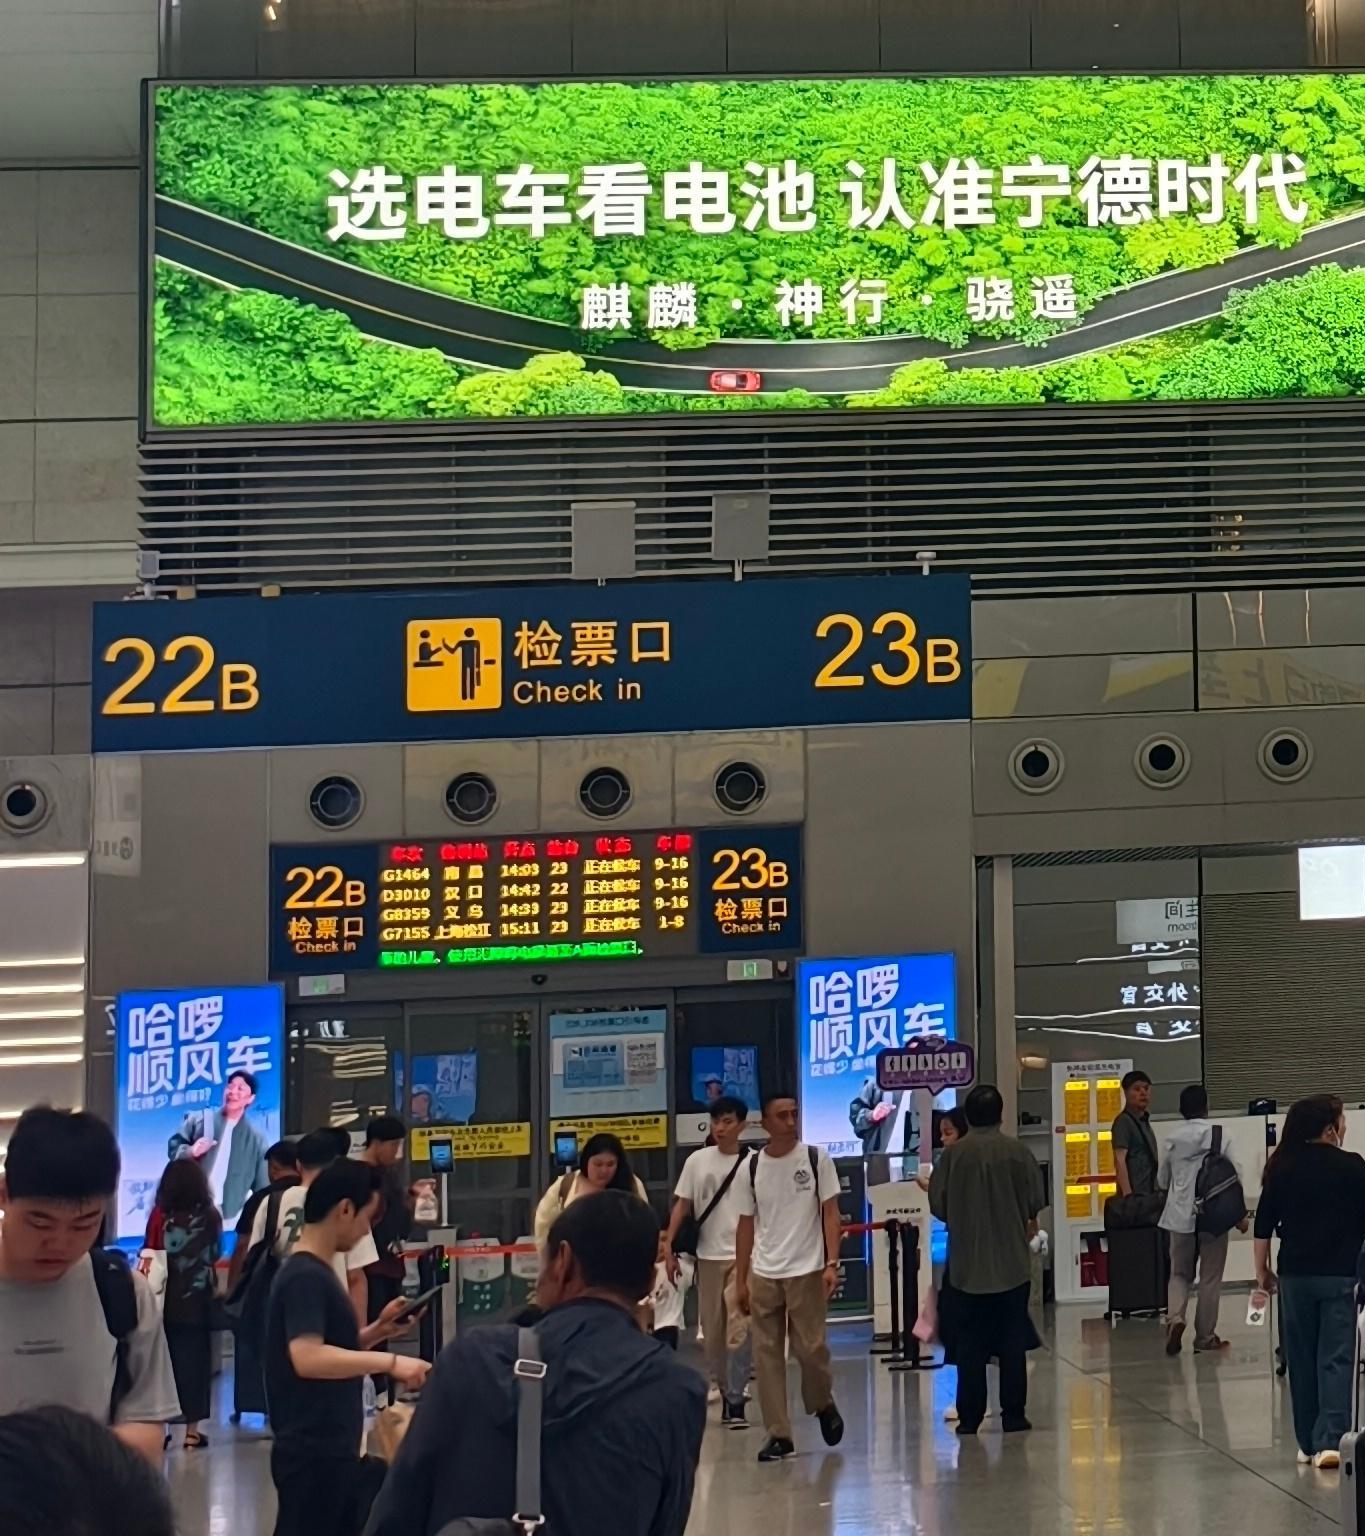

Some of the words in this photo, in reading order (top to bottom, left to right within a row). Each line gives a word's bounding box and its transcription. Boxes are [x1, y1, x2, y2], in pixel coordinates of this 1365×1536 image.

[327, 160, 817, 241] 选电车看电池
[839, 153, 1309, 230] 认准宁德时代
[513, 620, 671, 670] 检票口
[815, 612, 961, 688] 23B
[102, 635, 260, 715] 22B
[513, 680, 603, 705] Check
[618, 678, 641, 700] in
[286, 866, 366, 909] 22B
[549, 861, 569, 875] 23
[712, 848, 789, 890] 23B
[383, 888, 430, 902] D3010
[501, 884, 541, 898] 14:42
[549, 882, 569, 895] 22
[549, 901, 569, 915] 23
[715, 898, 788, 922] 检票口
[287, 917, 364, 941] 检票口
[295, 940, 339, 954] Check
[343, 939, 356, 952] in
[501, 922, 540, 936] 15:11
[549, 920, 569, 934] 23
[721, 921, 764, 935] Check
[768, 921, 781, 932] in
[809, 964, 899, 1015] 哈啰
[128, 995, 223, 1048] 哈啰
[810, 1003, 947, 1062] 顺风车
[128, 1036, 272, 1097] 顺风车
